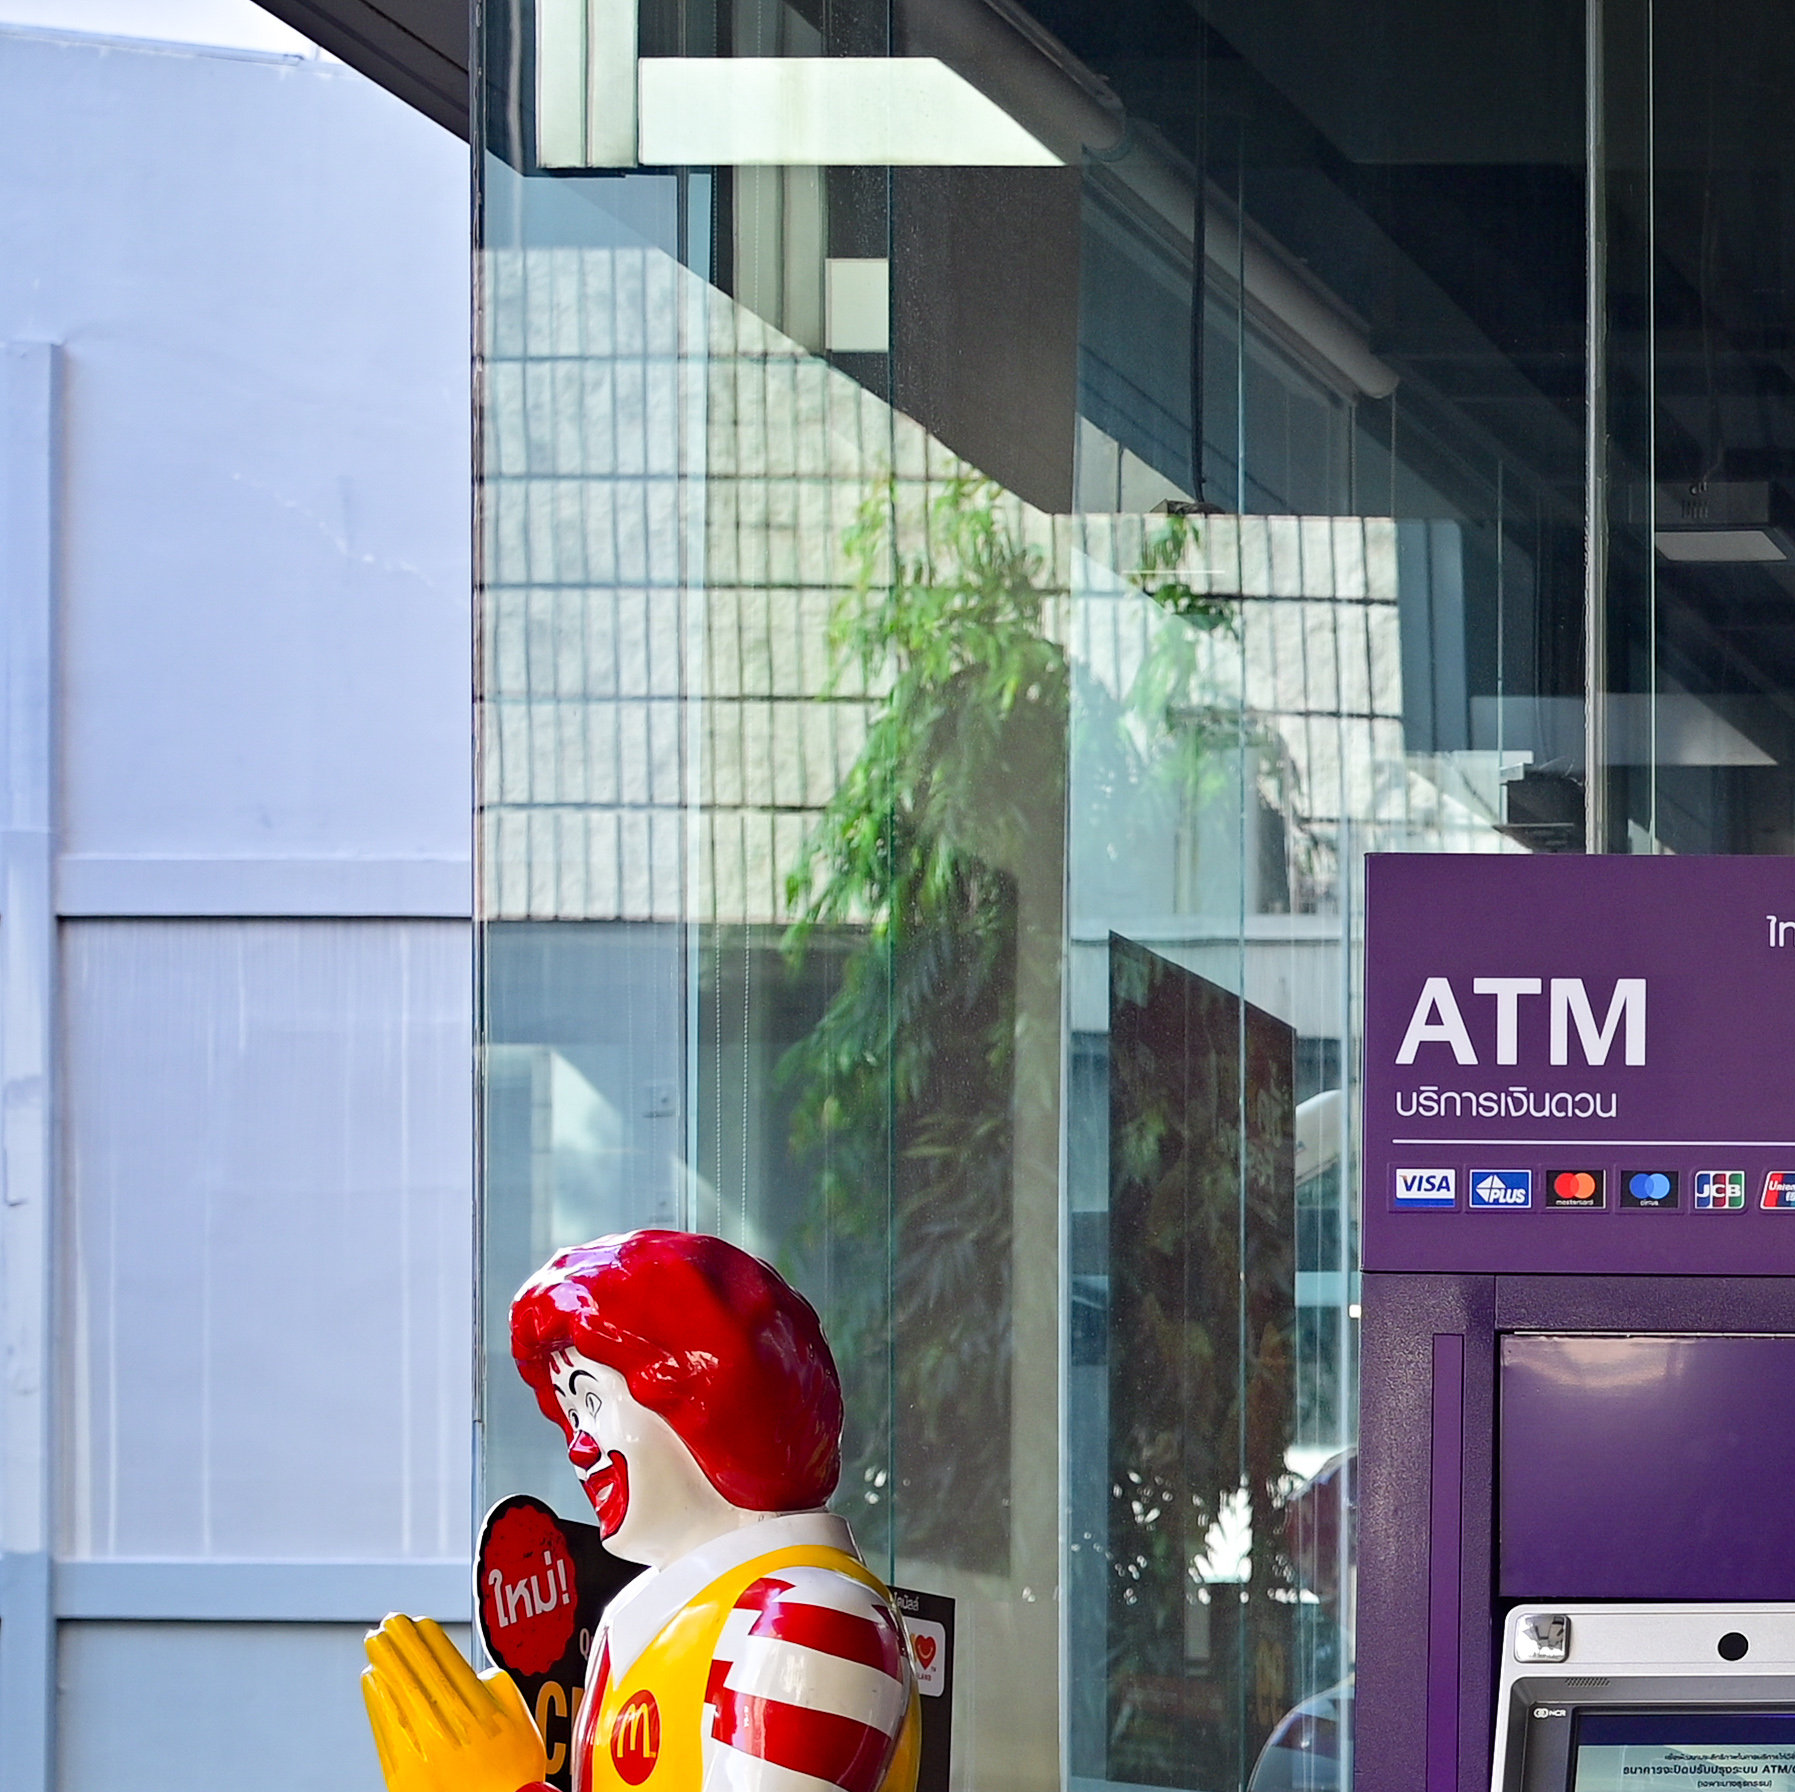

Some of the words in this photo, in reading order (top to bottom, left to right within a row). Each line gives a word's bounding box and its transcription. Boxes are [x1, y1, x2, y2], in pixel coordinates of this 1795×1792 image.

[1395, 977, 1647, 1066] ATM
[1399, 1175, 1451, 1192] VISA
[1696, 1184, 1741, 1198] JCB
[1491, 1188, 1526, 1203] PLUS
[488, 1551, 570, 1628] ใหม่!
[1549, 1709, 1566, 1717] NCR
